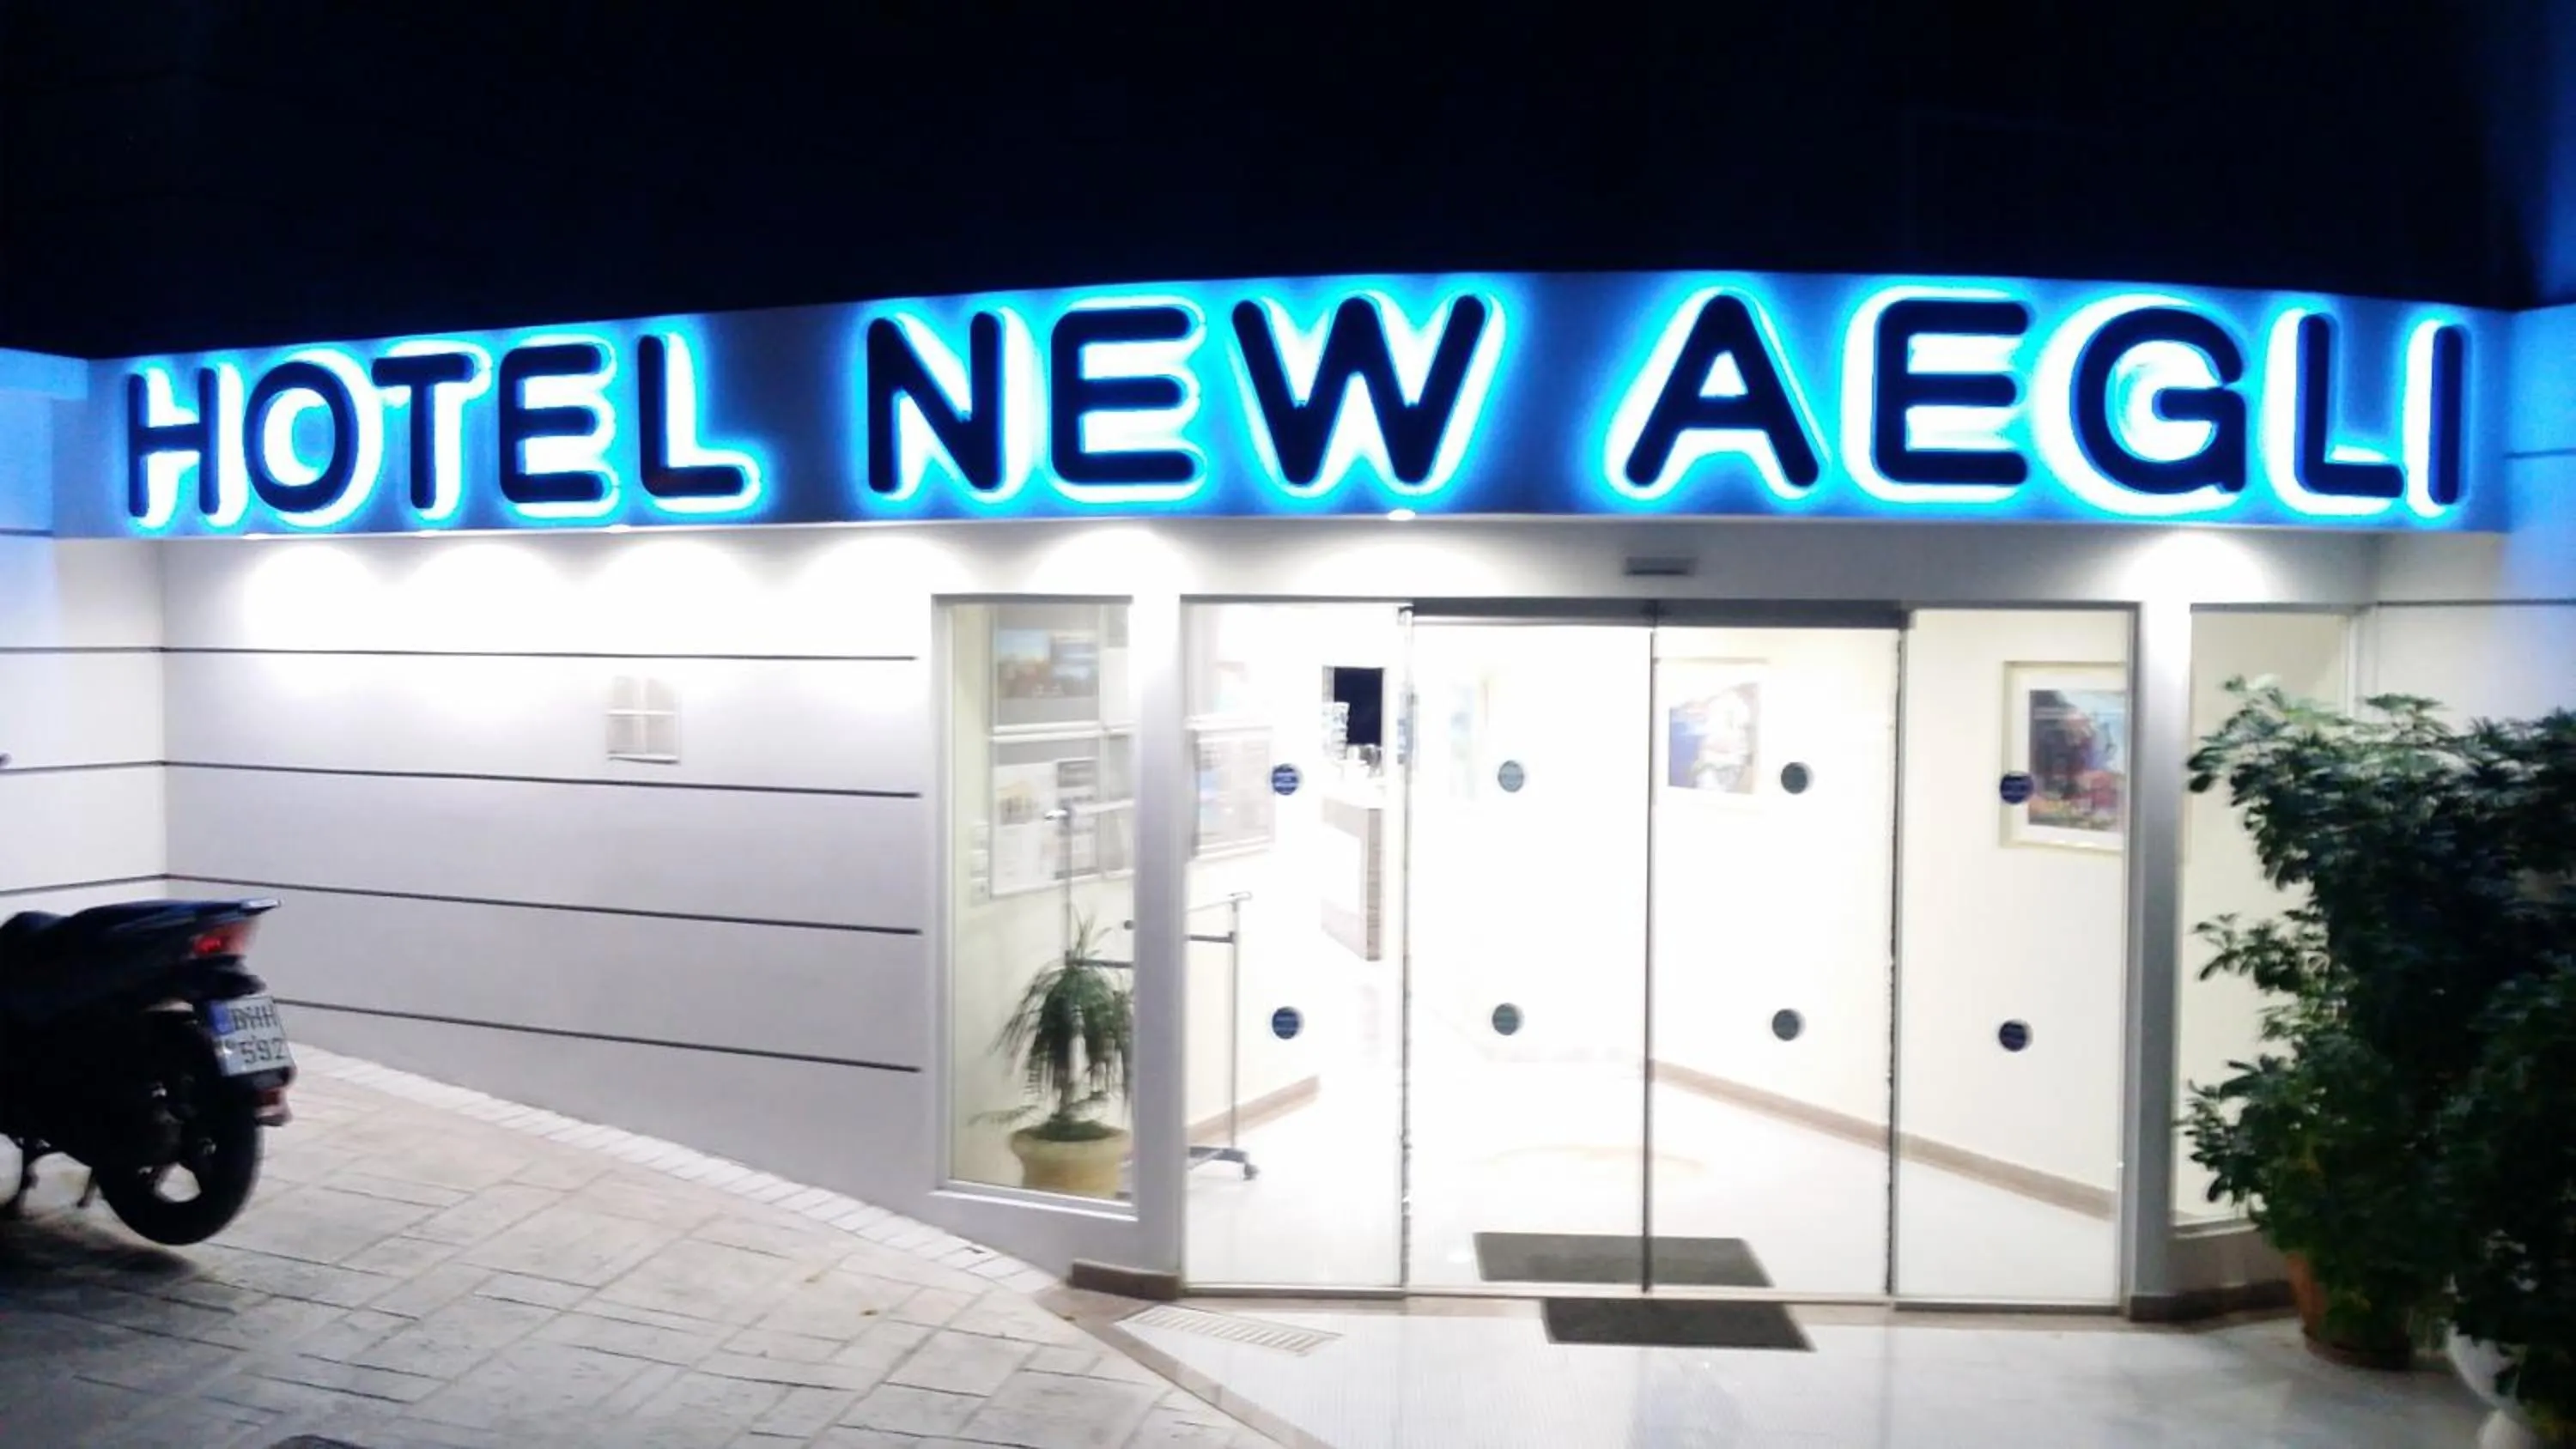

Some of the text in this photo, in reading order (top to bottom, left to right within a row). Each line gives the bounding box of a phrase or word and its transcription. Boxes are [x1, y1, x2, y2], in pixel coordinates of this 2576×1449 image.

[127, 293, 2465, 518] HOTEL NEW AEGLI
[239, 1036, 288, 1064] 592
